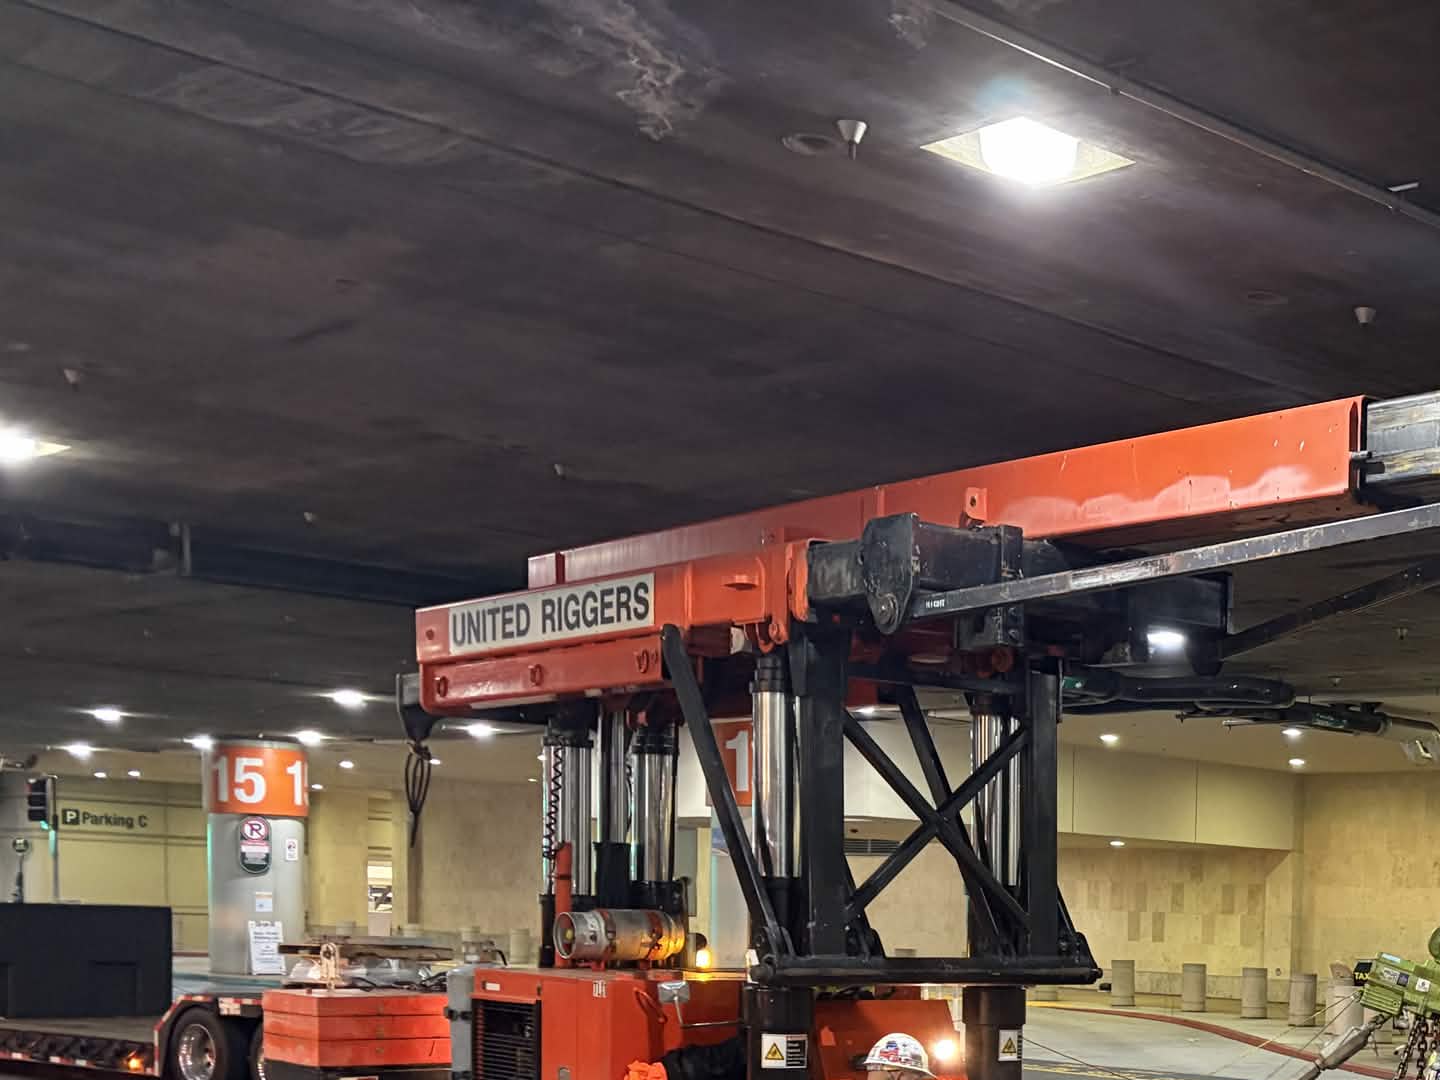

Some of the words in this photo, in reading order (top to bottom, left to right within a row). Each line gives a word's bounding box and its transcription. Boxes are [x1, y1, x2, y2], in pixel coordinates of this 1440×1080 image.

[452, 602, 531, 647] UNITED
[541, 581, 650, 635] RIGGERS
[215, 755, 267, 804] 15
[286, 760, 309, 806] 1
[725, 729, 749, 792] 1
[82, 811, 134, 829] Parking
[138, 815, 149, 828] C
[1354, 972, 1369, 981] TAX
